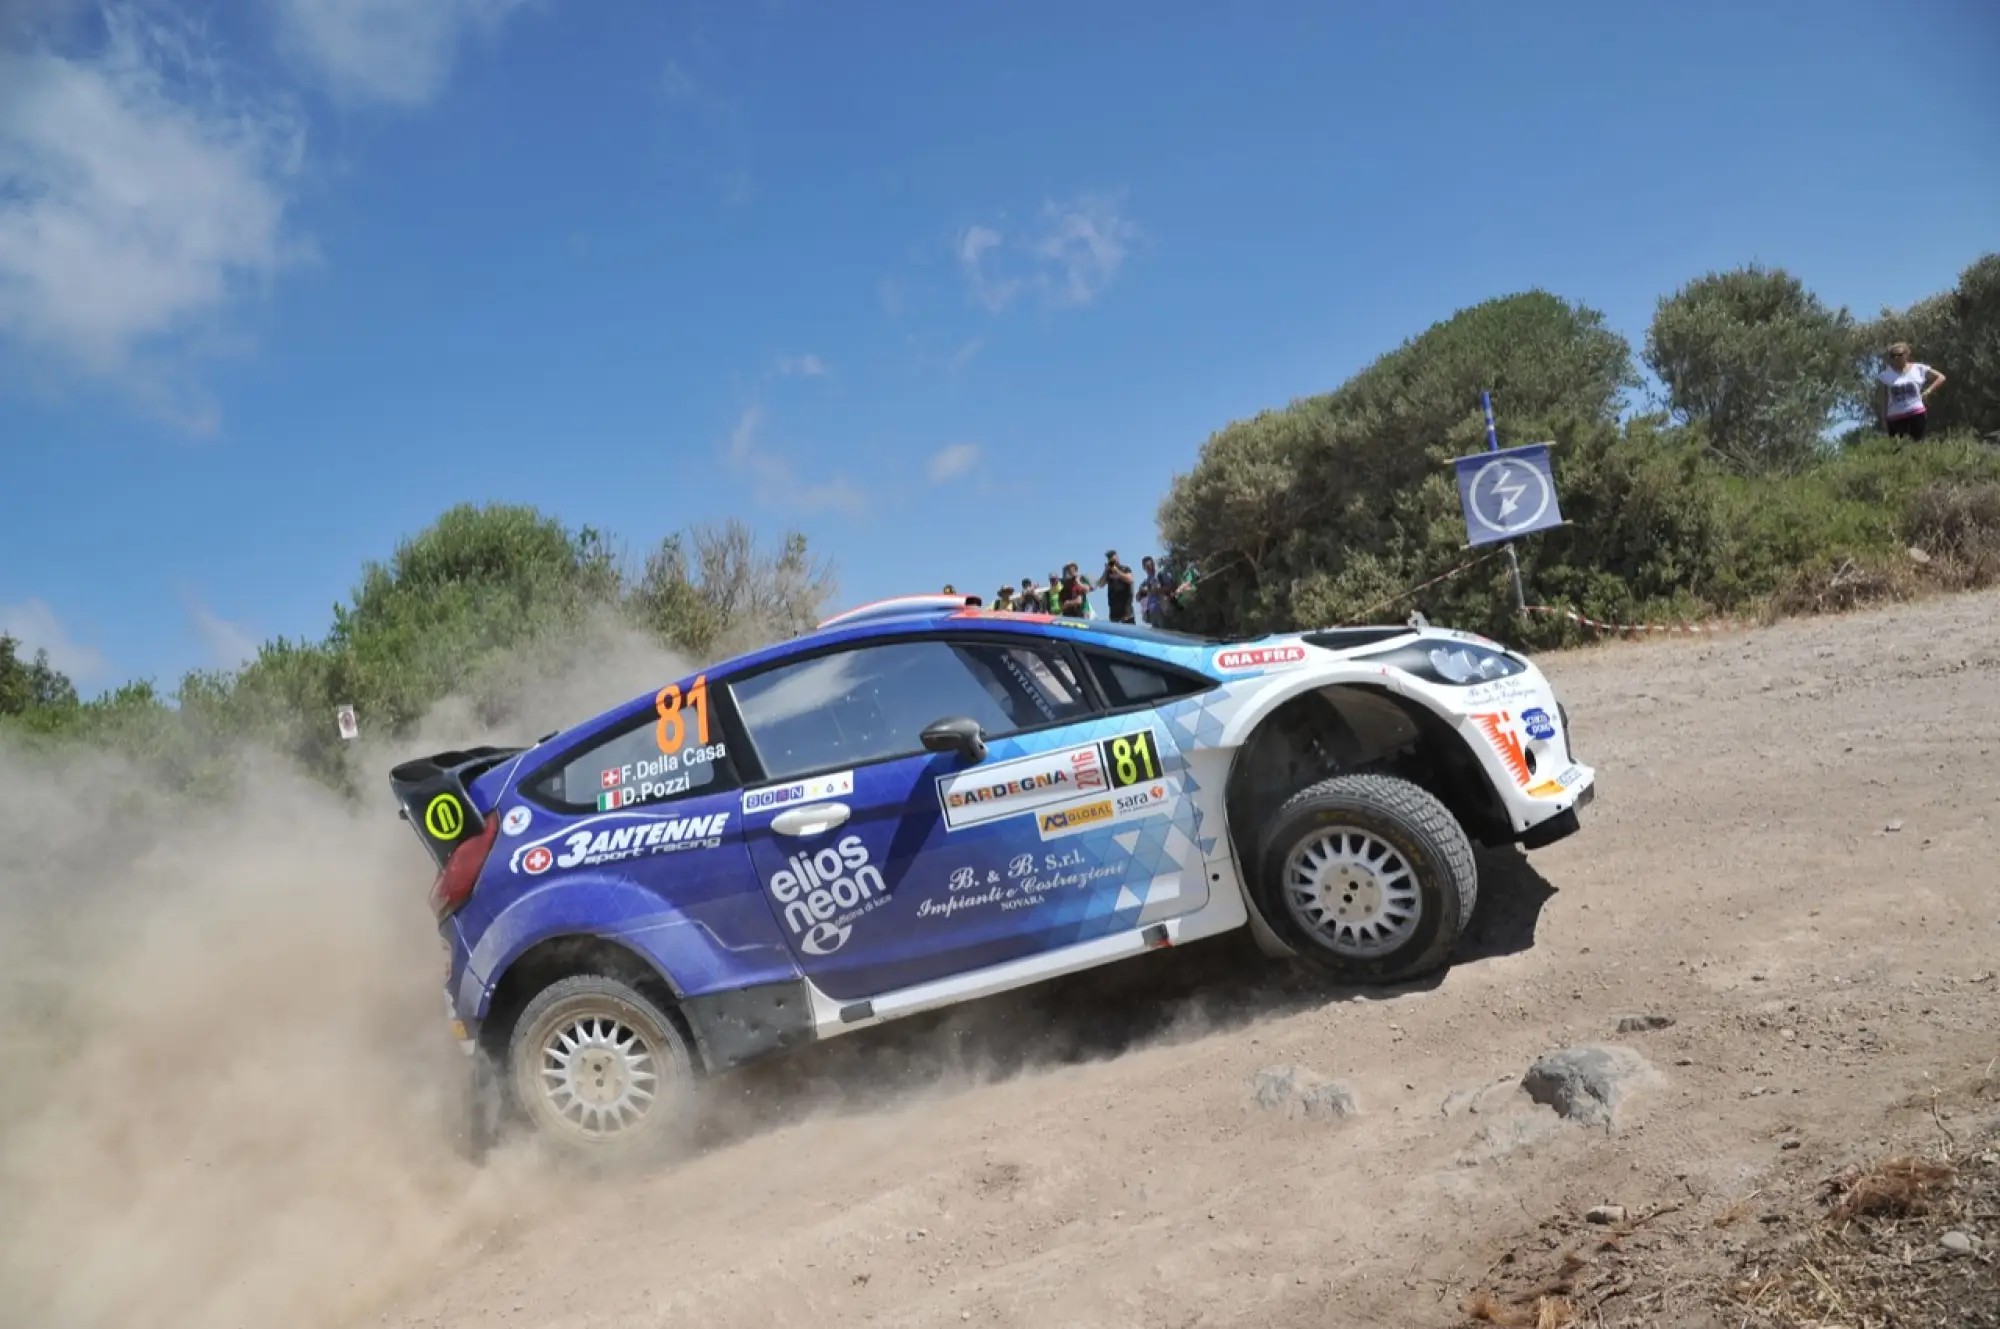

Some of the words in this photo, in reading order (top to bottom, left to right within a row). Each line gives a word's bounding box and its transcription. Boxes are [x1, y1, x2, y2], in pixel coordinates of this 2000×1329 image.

[655, 674, 709, 754] 81
[621, 754, 678, 785] F.Della
[683, 742, 726, 766] Casa
[1071, 751, 1101, 790] 2016
[1112, 733, 1155, 786] 81
[622, 771, 690, 805] D.Pozzi
[949, 769, 1067, 808] SARDEGNA
[1117, 791, 1149, 810] sara
[1068, 805, 1112, 823] GLOBAL
[557, 812, 730, 868] 3ANTENNE
[584, 847, 644, 865] sport
[652, 837, 721, 854] racing
[770, 835, 869, 902] elios
[949, 866, 980, 892] B.
[987, 870, 1000, 883] &
[1008, 853, 1039, 878] B.
[1045, 849, 1086, 871] S.r.l.
[784, 865, 886, 934] neon
[916, 885, 1004, 918] Impianti
[1001, 894, 1045, 912] NOVARA
